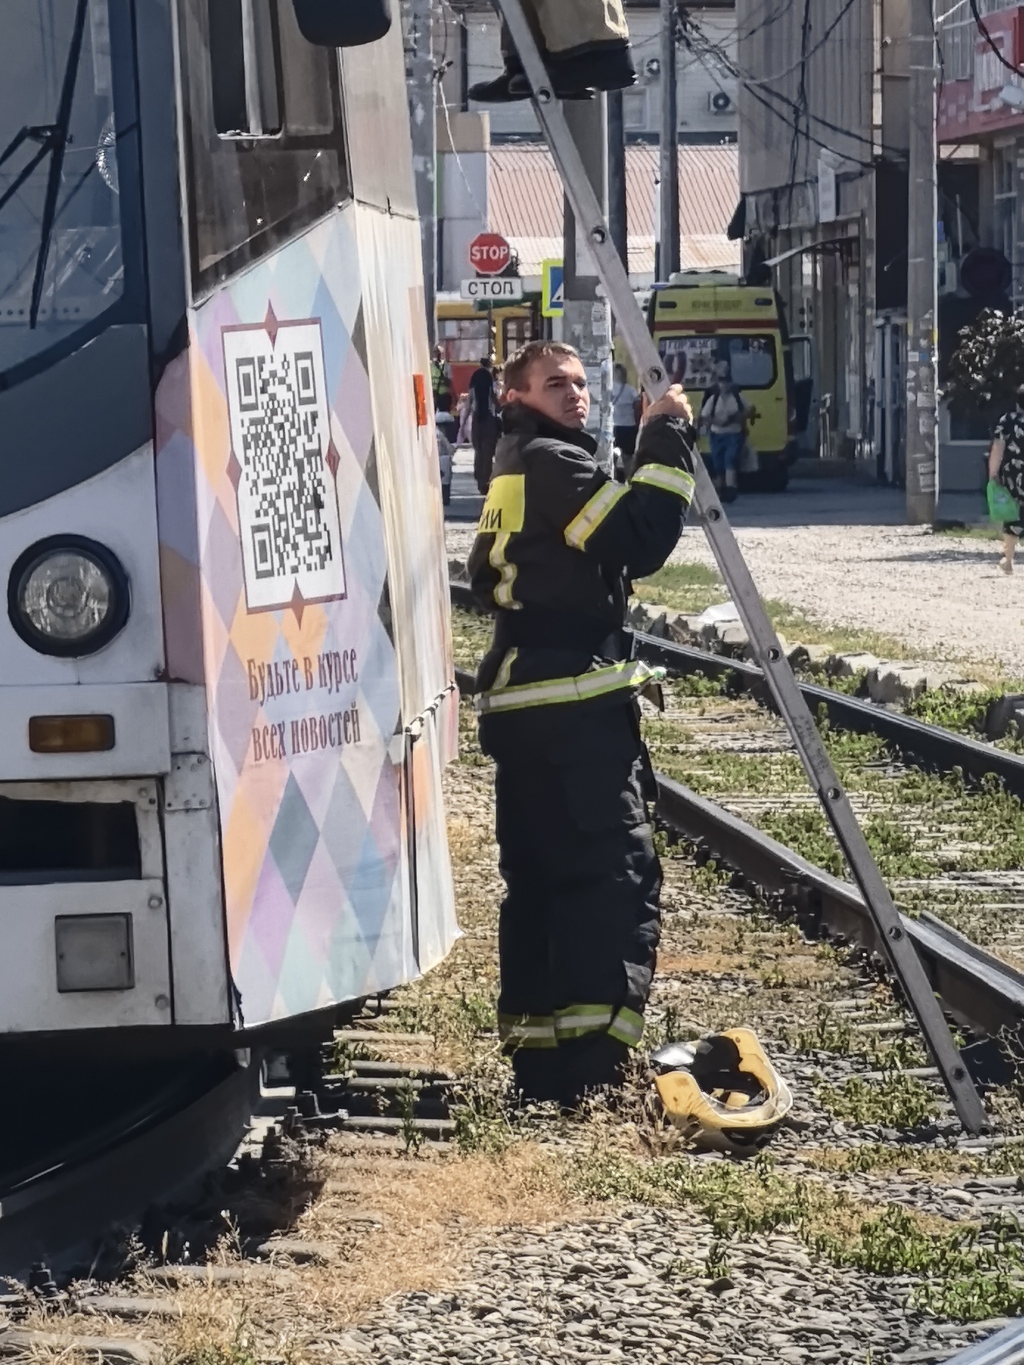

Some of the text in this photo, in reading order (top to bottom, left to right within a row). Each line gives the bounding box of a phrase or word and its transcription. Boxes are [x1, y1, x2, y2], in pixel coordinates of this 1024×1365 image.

[471, 245, 508, 261] STOP
[468, 281, 514, 295] СТОП
[247, 648, 359, 707] Будьте в курсе
[252, 701, 361, 762] всех новостей
